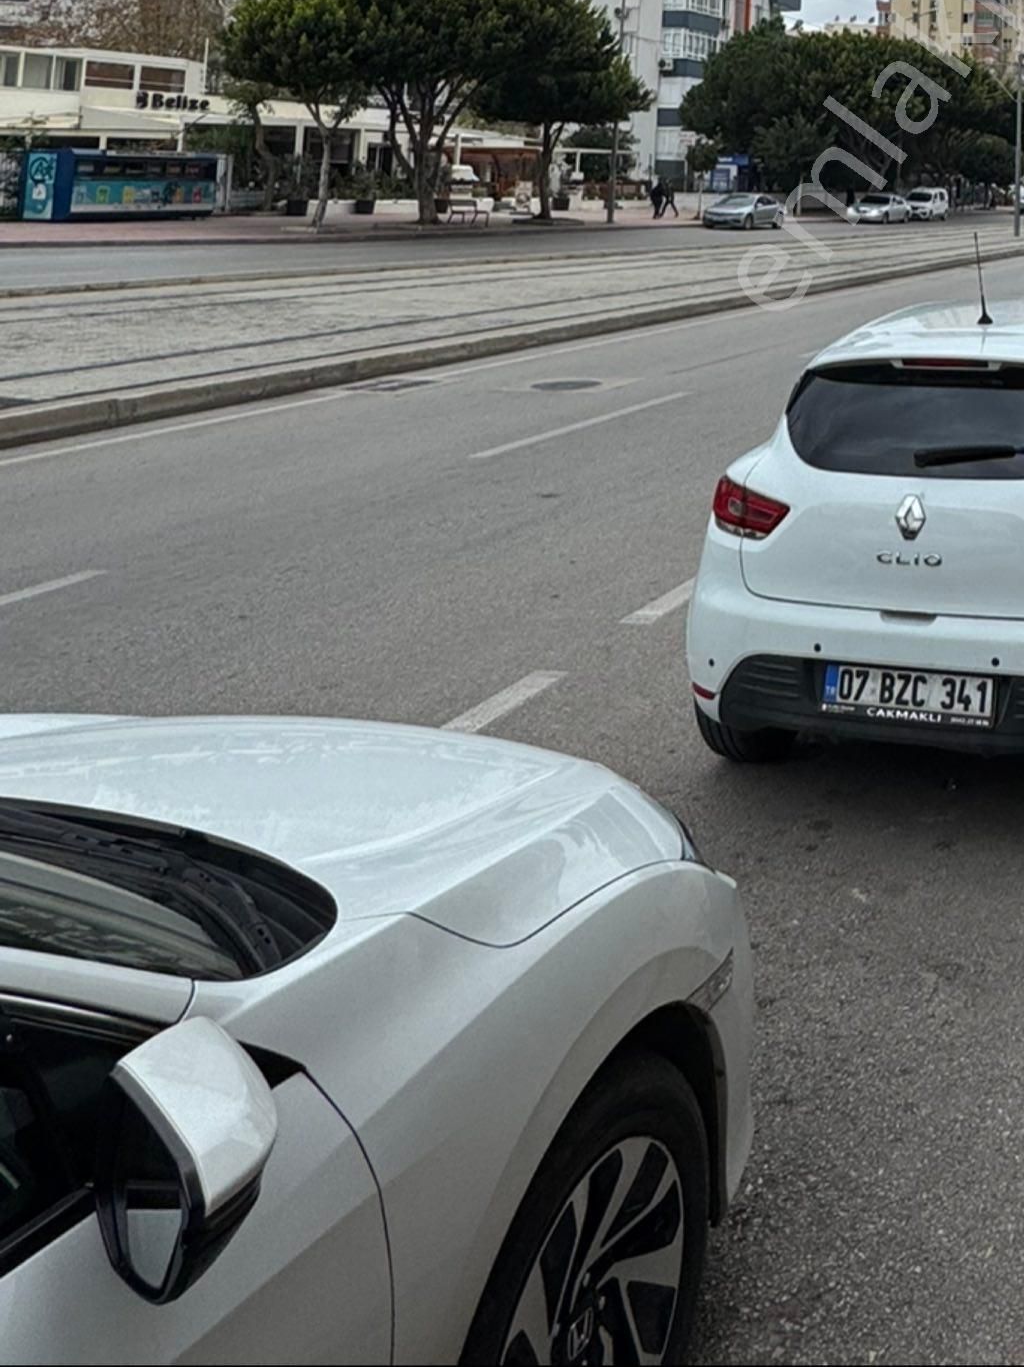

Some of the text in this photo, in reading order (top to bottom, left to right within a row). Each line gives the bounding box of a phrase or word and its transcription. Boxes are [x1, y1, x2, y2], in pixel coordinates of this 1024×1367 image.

[151, 93, 210, 111] Belize
[877, 550, 943, 567] CLIO
[838, 667, 987, 713] 07 BZC 341
